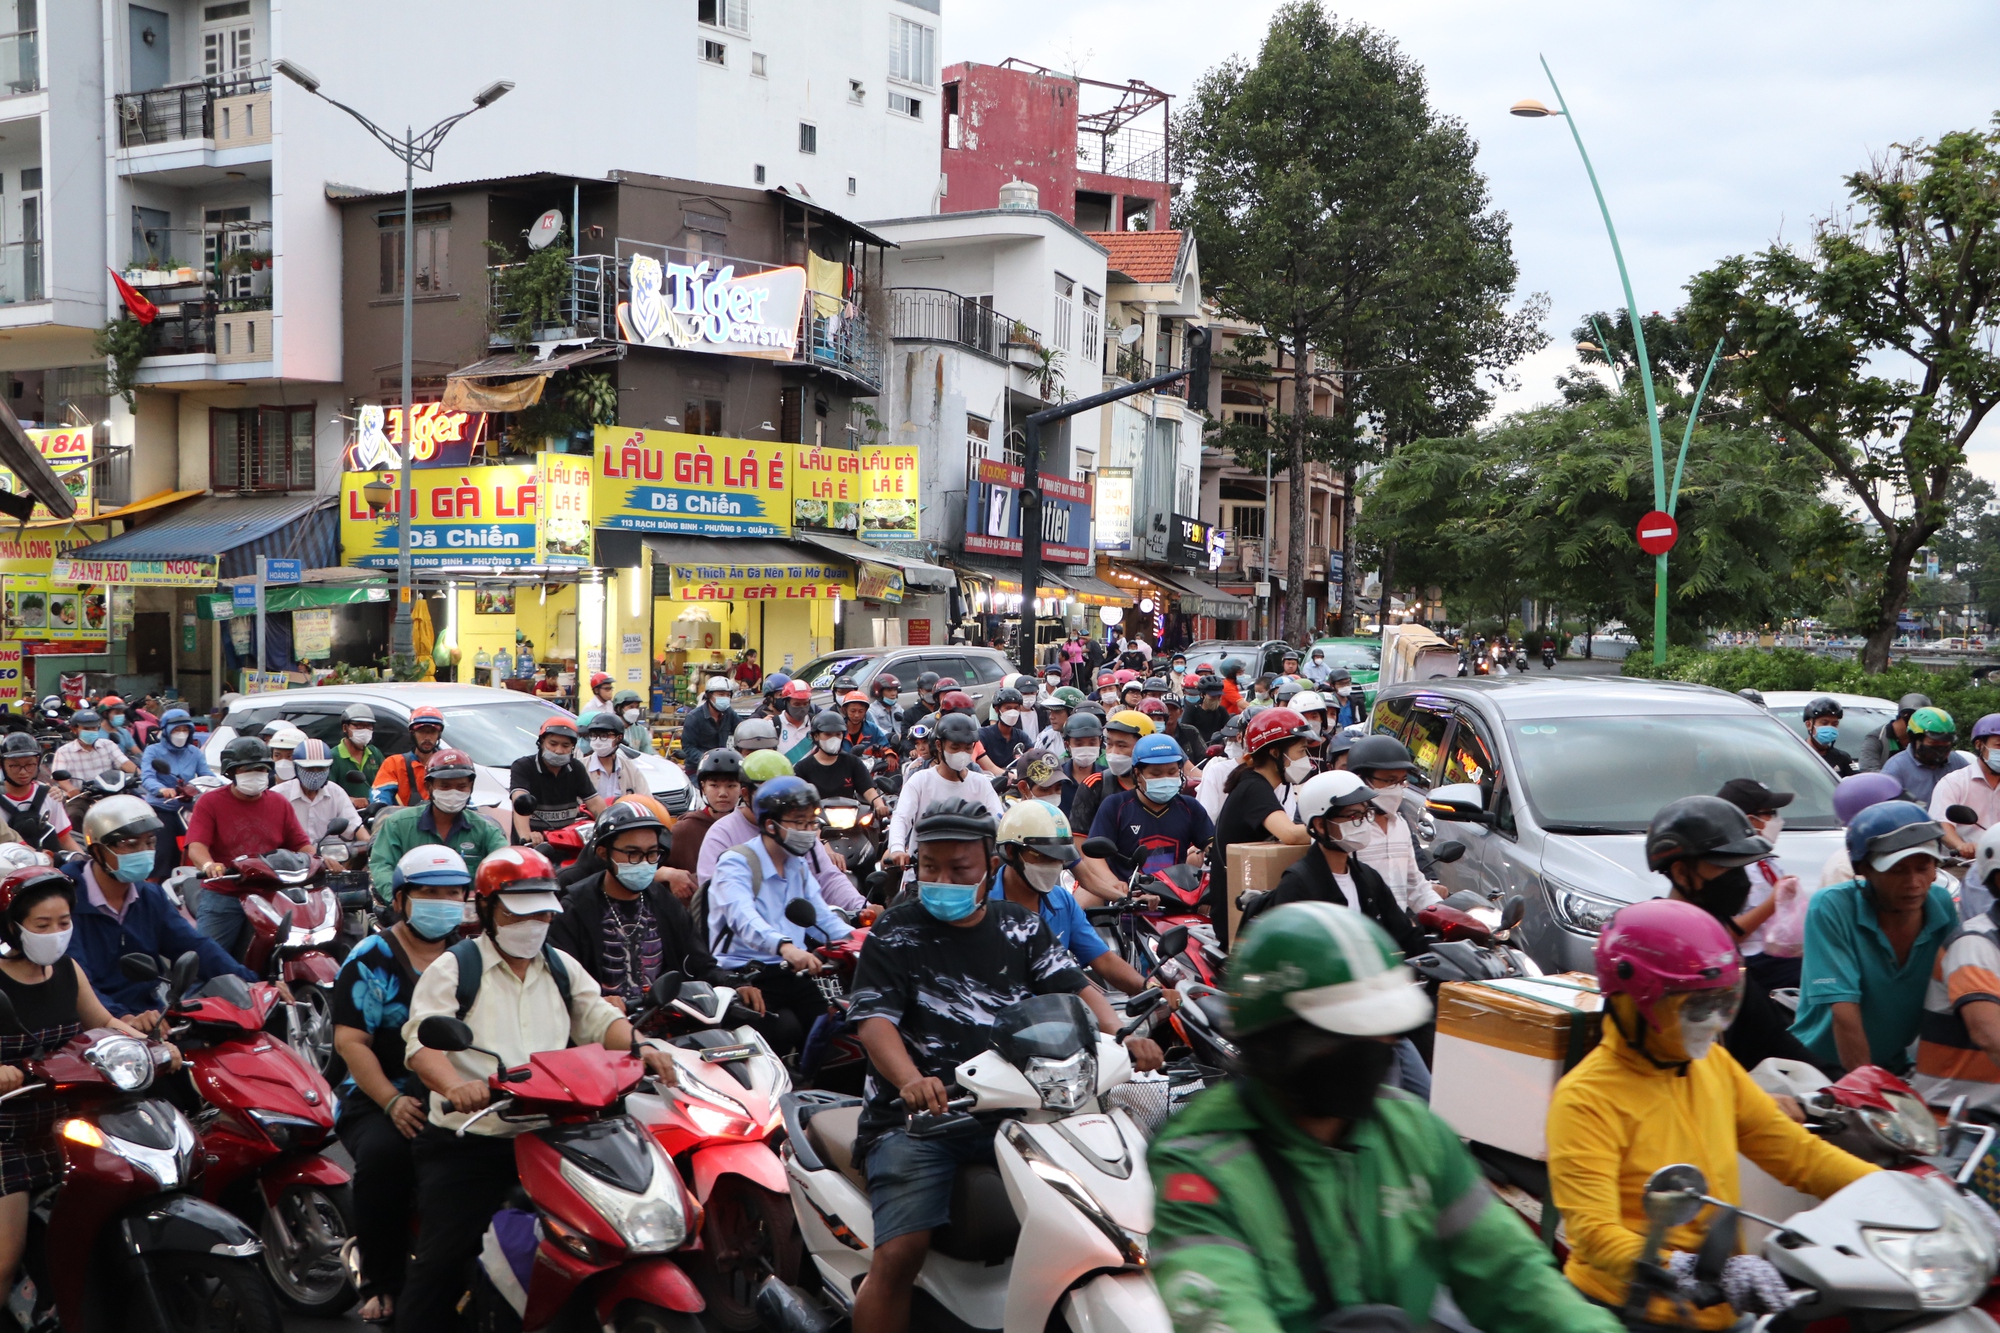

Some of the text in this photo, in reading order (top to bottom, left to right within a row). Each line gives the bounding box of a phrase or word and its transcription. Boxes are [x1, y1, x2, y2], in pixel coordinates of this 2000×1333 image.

[666, 260, 770, 343] Tiger
[730, 323, 796, 348] CRYSTAL
[388, 402, 468, 460] Tiger
[40, 434, 86, 454] 18A
[604, 432, 785, 490] LẨU GÀ LÁ É
[800, 446, 859, 474] LẨU GÀ
[863, 450, 914, 470] LẨU GÀ
[548, 460, 590, 486] LẨU GÀ
[813, 478, 847, 499] LÁ É
[873, 475, 903, 492] LÁ É
[431, 477, 480, 518] GÀ
[495, 476, 537, 517] LÁ
[556, 491, 580, 510] LÁ É
[652, 492, 678, 510] Dã
[1106, 489, 1123, 499] DUY
[635, 520, 656, 529] RẠCH
[657, 519, 678, 529] BÙNG
[680, 522, 697, 530] BINH
[704, 523, 735, 533] PHƯỜNG
[748, 526, 767, 535] QUẬN
[410, 530, 438, 546] Dã
[414, 556, 439, 565] BÙNG
[472, 555, 512, 565] PHƯỜNG
[269, 570, 298, 580] HOÀNG SA
[676, 568, 692, 581] Vợ
[696, 566, 725, 579] Thích
[729, 565, 743, 578] Ăn
[764, 566, 784, 578] Nên
[787, 567, 802, 578] Tôi
[805, 566, 820, 578] Mở
[824, 567, 848, 580] Quán
[682, 582, 841, 600] LẨU GÀ LÁ É
[783, 730, 788, 740] 8
